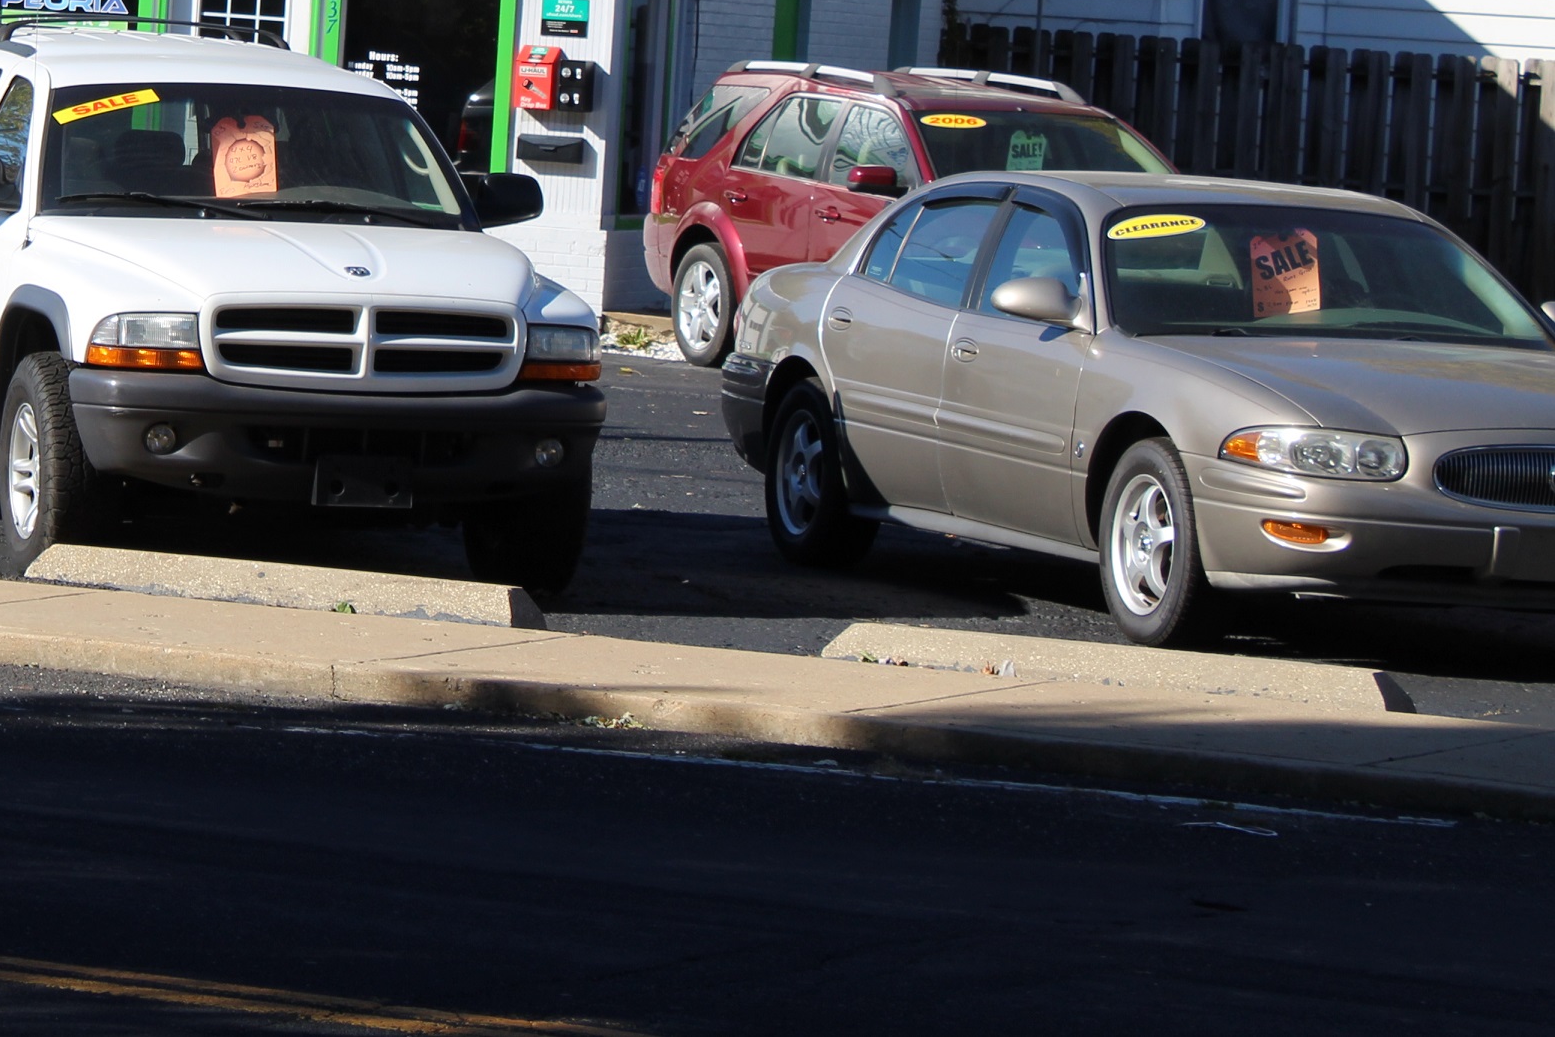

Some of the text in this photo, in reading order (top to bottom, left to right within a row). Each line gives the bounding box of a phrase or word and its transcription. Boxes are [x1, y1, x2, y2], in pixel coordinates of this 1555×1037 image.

[555, 5, 575, 13] 24/7
[369, 51, 399, 62] Hours:
[72, 93, 140, 115] SALE
[929, 117, 978, 125] 2006
[1011, 143, 1043, 159] SALE!
[1115, 219, 1198, 236] CLEARANCE
[1255, 240, 1315, 280] SALE
